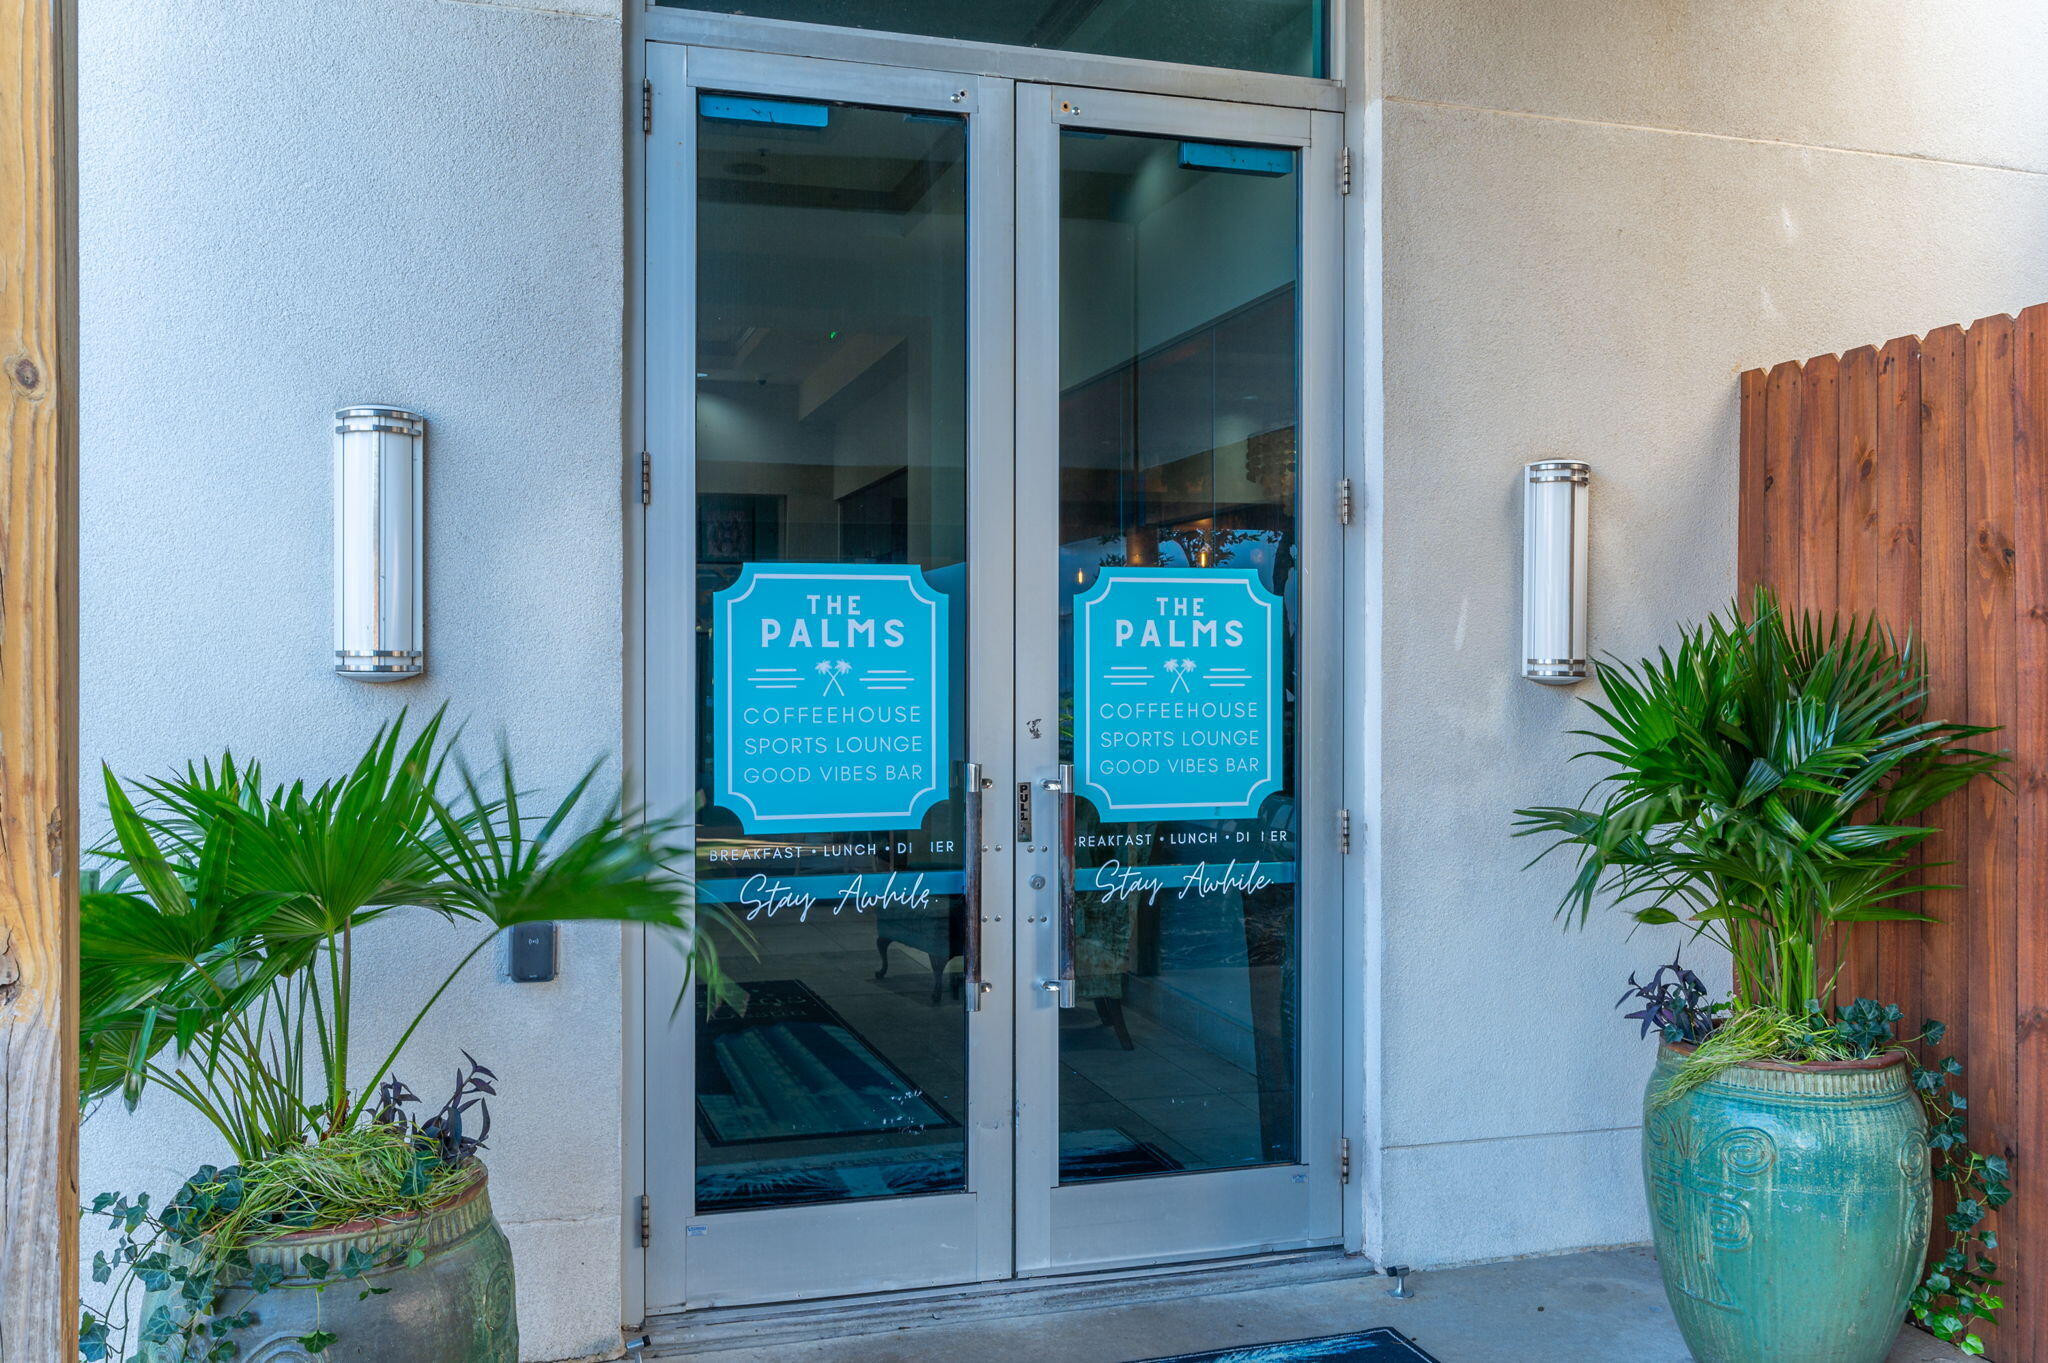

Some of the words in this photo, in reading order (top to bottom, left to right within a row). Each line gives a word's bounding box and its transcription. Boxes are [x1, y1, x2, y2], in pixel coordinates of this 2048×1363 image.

[806, 594, 861, 615] THE
[1156, 597, 1205, 617] THE
[761, 618, 905, 648] PALMS
[1115, 619, 1244, 648] PALMS
[743, 705, 921, 725] COFFEEHOUSE
[1099, 702, 1258, 719] COFFEEHOUSE
[744, 736, 827, 755] SPORTS
[836, 736, 922, 753] LOUNGE
[1100, 731, 1174, 748] SPORTS
[1182, 729, 1259, 746] LOUNGE
[743, 767, 811, 784] GOOD
[819, 765, 878, 782] VIBES
[885, 764, 922, 781] BAR
[1099, 759, 1160, 775] GOOD
[1167, 757, 1218, 773] VIBES
[1226, 757, 1259, 773] BAR
[1020, 784, 1028, 821] PULL
[1170, 832, 1217, 845] LUNCH
[709, 846, 802, 862] BREAKFAST
[823, 843, 876, 857] LUNCH
[1095, 859, 1163, 906] Stay
[739, 873, 816, 923] Stay
